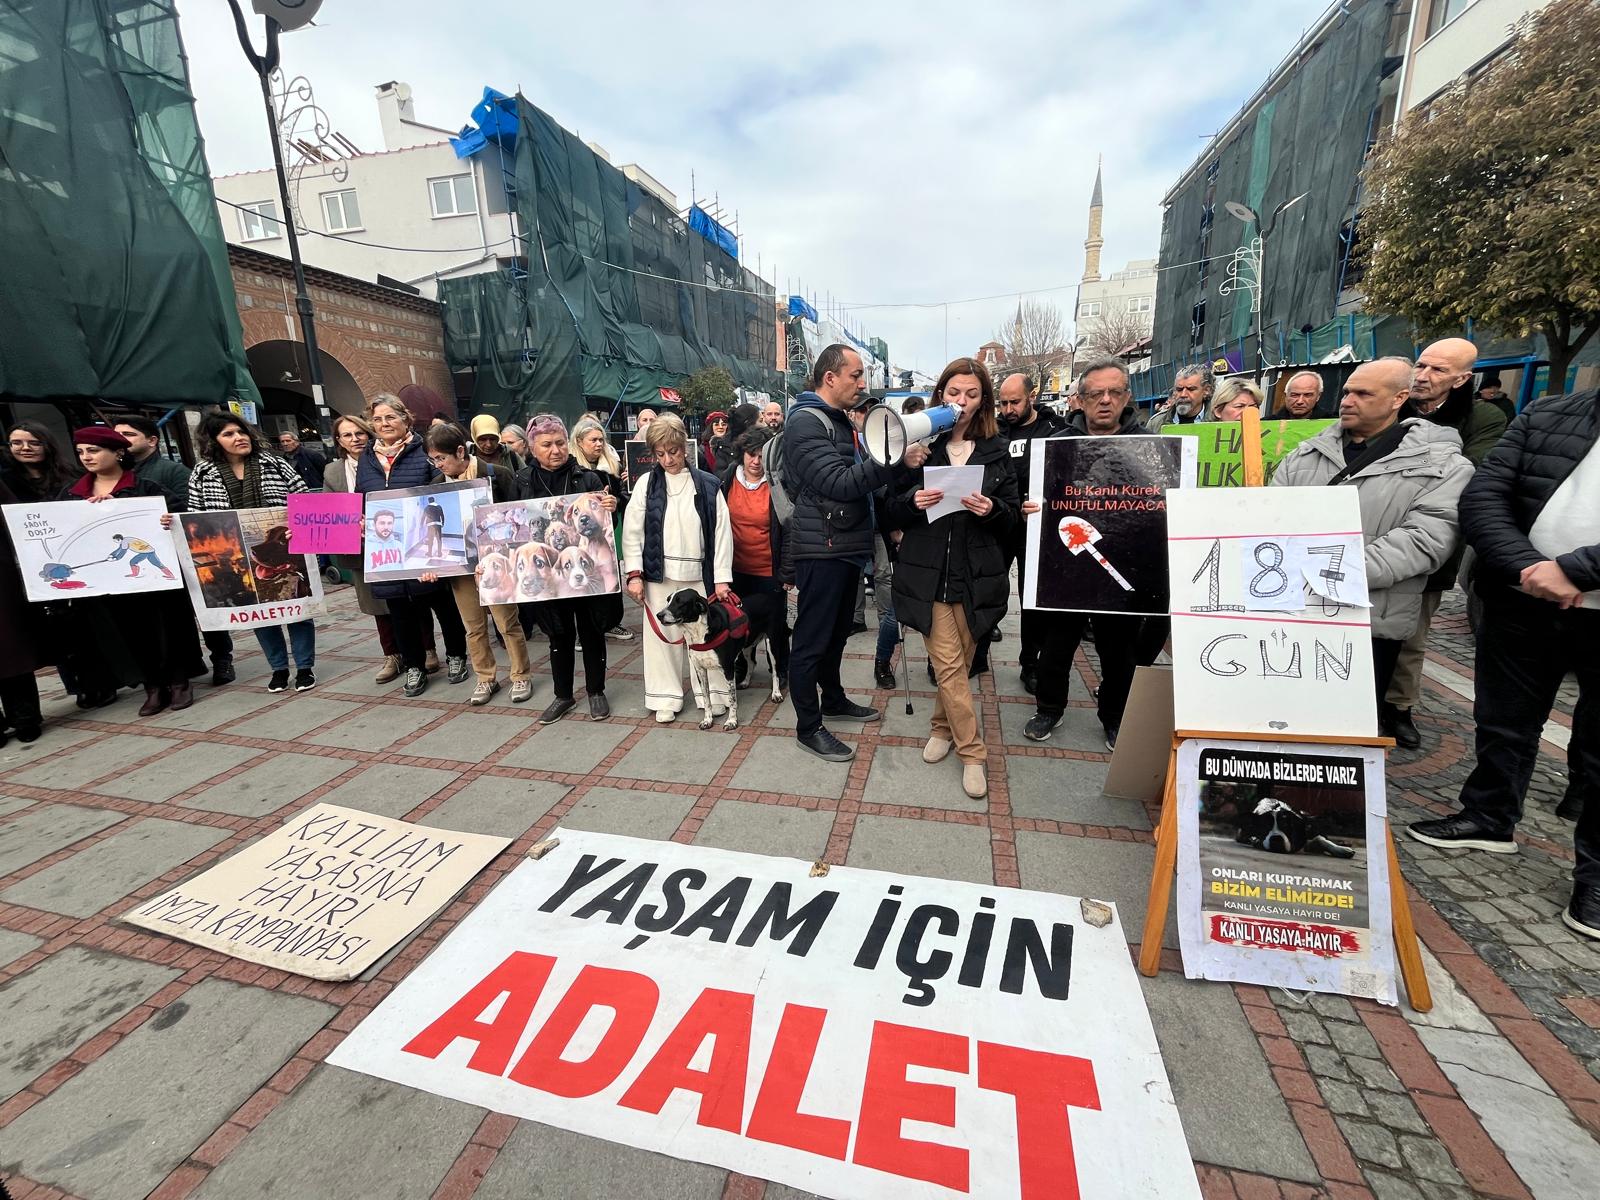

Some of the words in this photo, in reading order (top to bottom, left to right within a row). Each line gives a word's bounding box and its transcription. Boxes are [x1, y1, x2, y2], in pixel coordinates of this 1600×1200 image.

[1051, 500, 1167, 511] UNUTULMAYACA
[1065, 486, 1081, 496] Bu
[1085, 485, 1118, 496] Kanlı
[1122, 485, 1161, 496] Kürek
[26, 513, 41, 521] EN
[1190, 538, 1346, 613] 187
[229, 605, 302, 624] ADALET??
[1199, 628, 1353, 683] GÜN
[1205, 757, 1220, 776] BU
[1222, 756, 1271, 780] DÜNYADA
[1273, 758, 1324, 783] BİZLERDE
[1325, 765, 1358, 785] VARIZ
[288, 812, 464, 873] KATLİAM
[265, 845, 426, 906] YASASINA
[1211, 867, 1263, 882] ONLARI
[1265, 873, 1353, 891] KURTARMAK
[238, 876, 376, 929] HAYIR!
[1211, 879, 1261, 899] BİZİM
[1265, 886, 1355, 910] ELİMİZDE!
[1224, 900, 1252, 911] KANLI
[1254, 904, 1291, 916] YASAYA
[1292, 908, 1322, 920] HAYIR
[1324, 912, 1341, 921] DE!
[140, 891, 214, 928] İMZA
[201, 908, 373, 965] KAMPANYASI
[537, 853, 840, 951] YAŞAM
[853, 884, 1075, 1007] İÇİN
[1220, 921, 1255, 942] KANLI
[402, 950, 1103, 1200] ADALET
